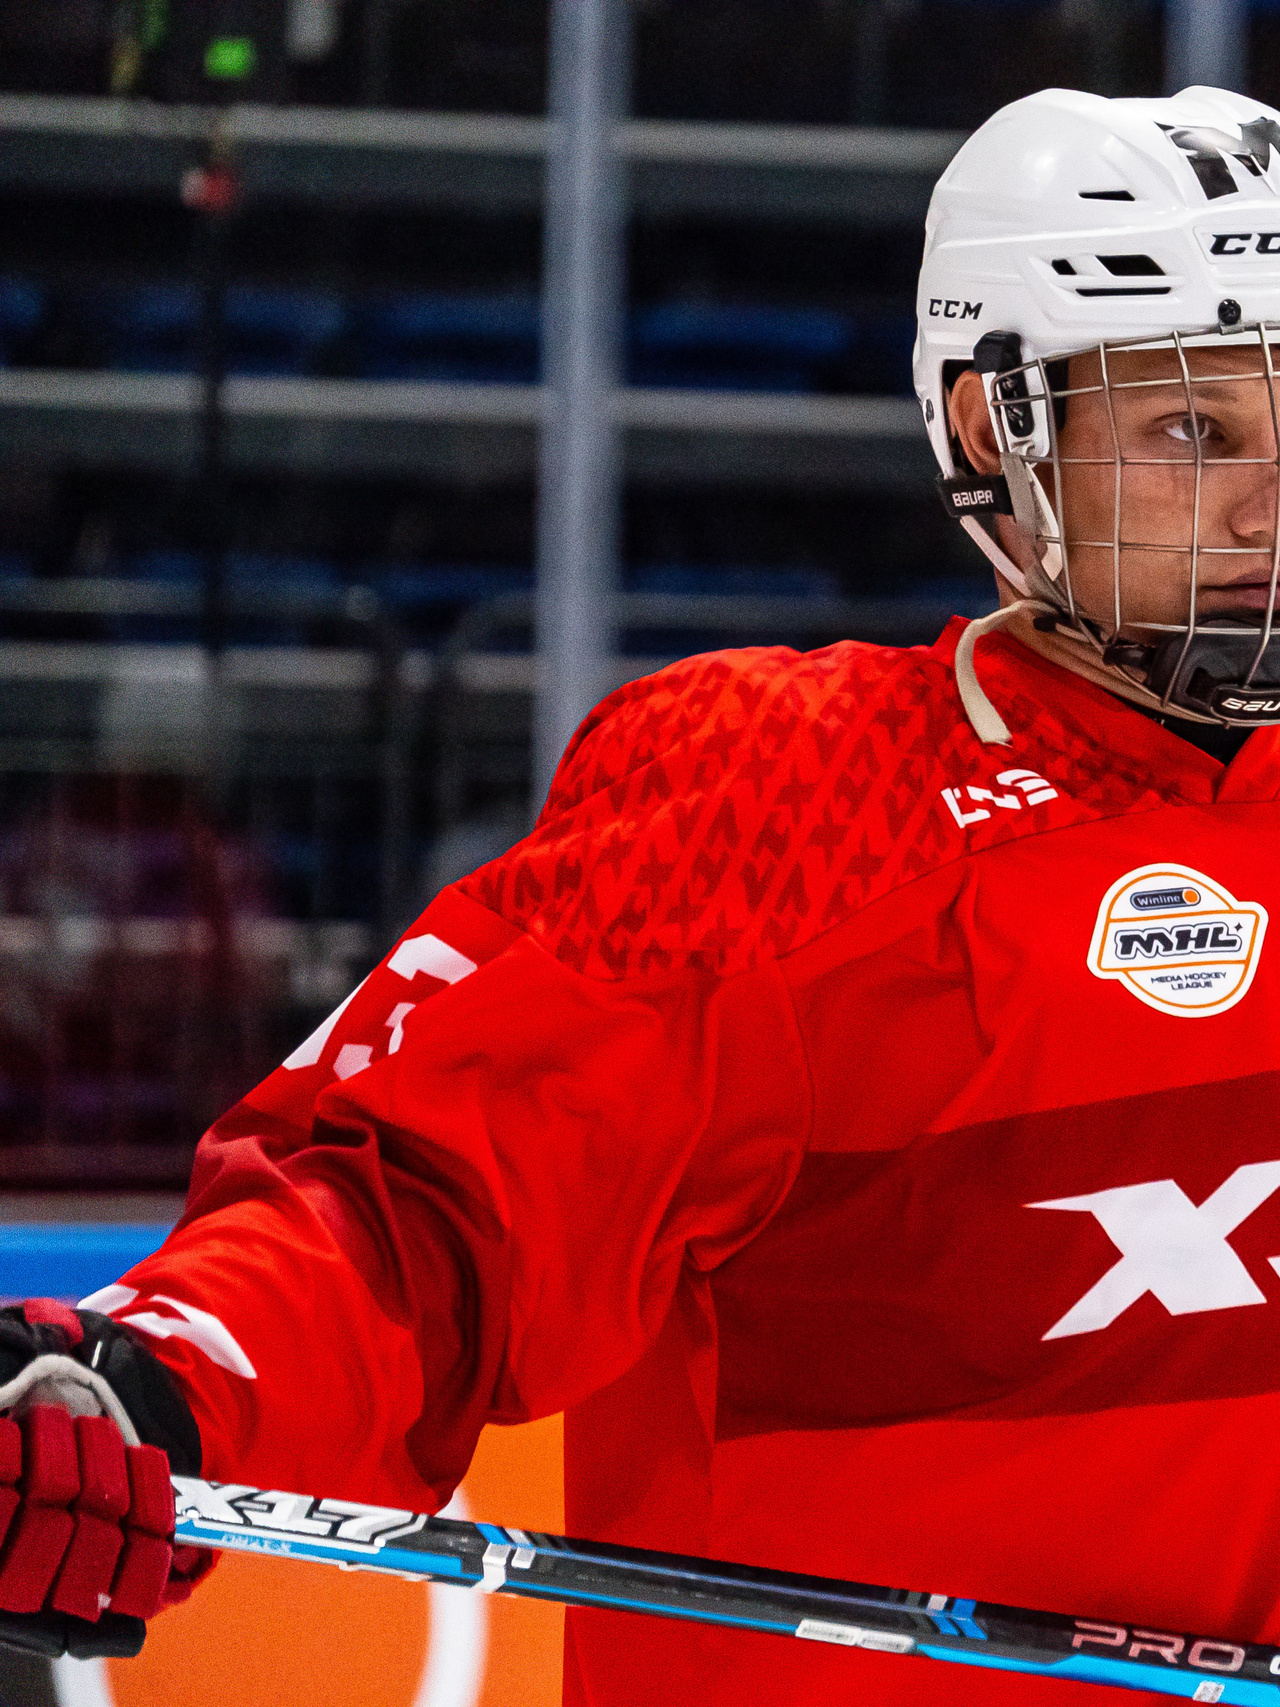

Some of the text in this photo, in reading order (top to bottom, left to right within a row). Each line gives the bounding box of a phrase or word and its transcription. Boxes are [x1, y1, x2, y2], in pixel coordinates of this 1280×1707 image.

[929, 298, 983, 320] CCM
[951, 489, 994, 507] BAUER
[1136, 893, 1181, 906] Winline
[1118, 926, 1238, 955] MHL
[1151, 971, 1227, 984] MEDIA HOCKEY
[1171, 980, 1213, 991] LEAGUE
[169, 1475, 414, 1543] X17
[1071, 1619, 1246, 1673] PRO
